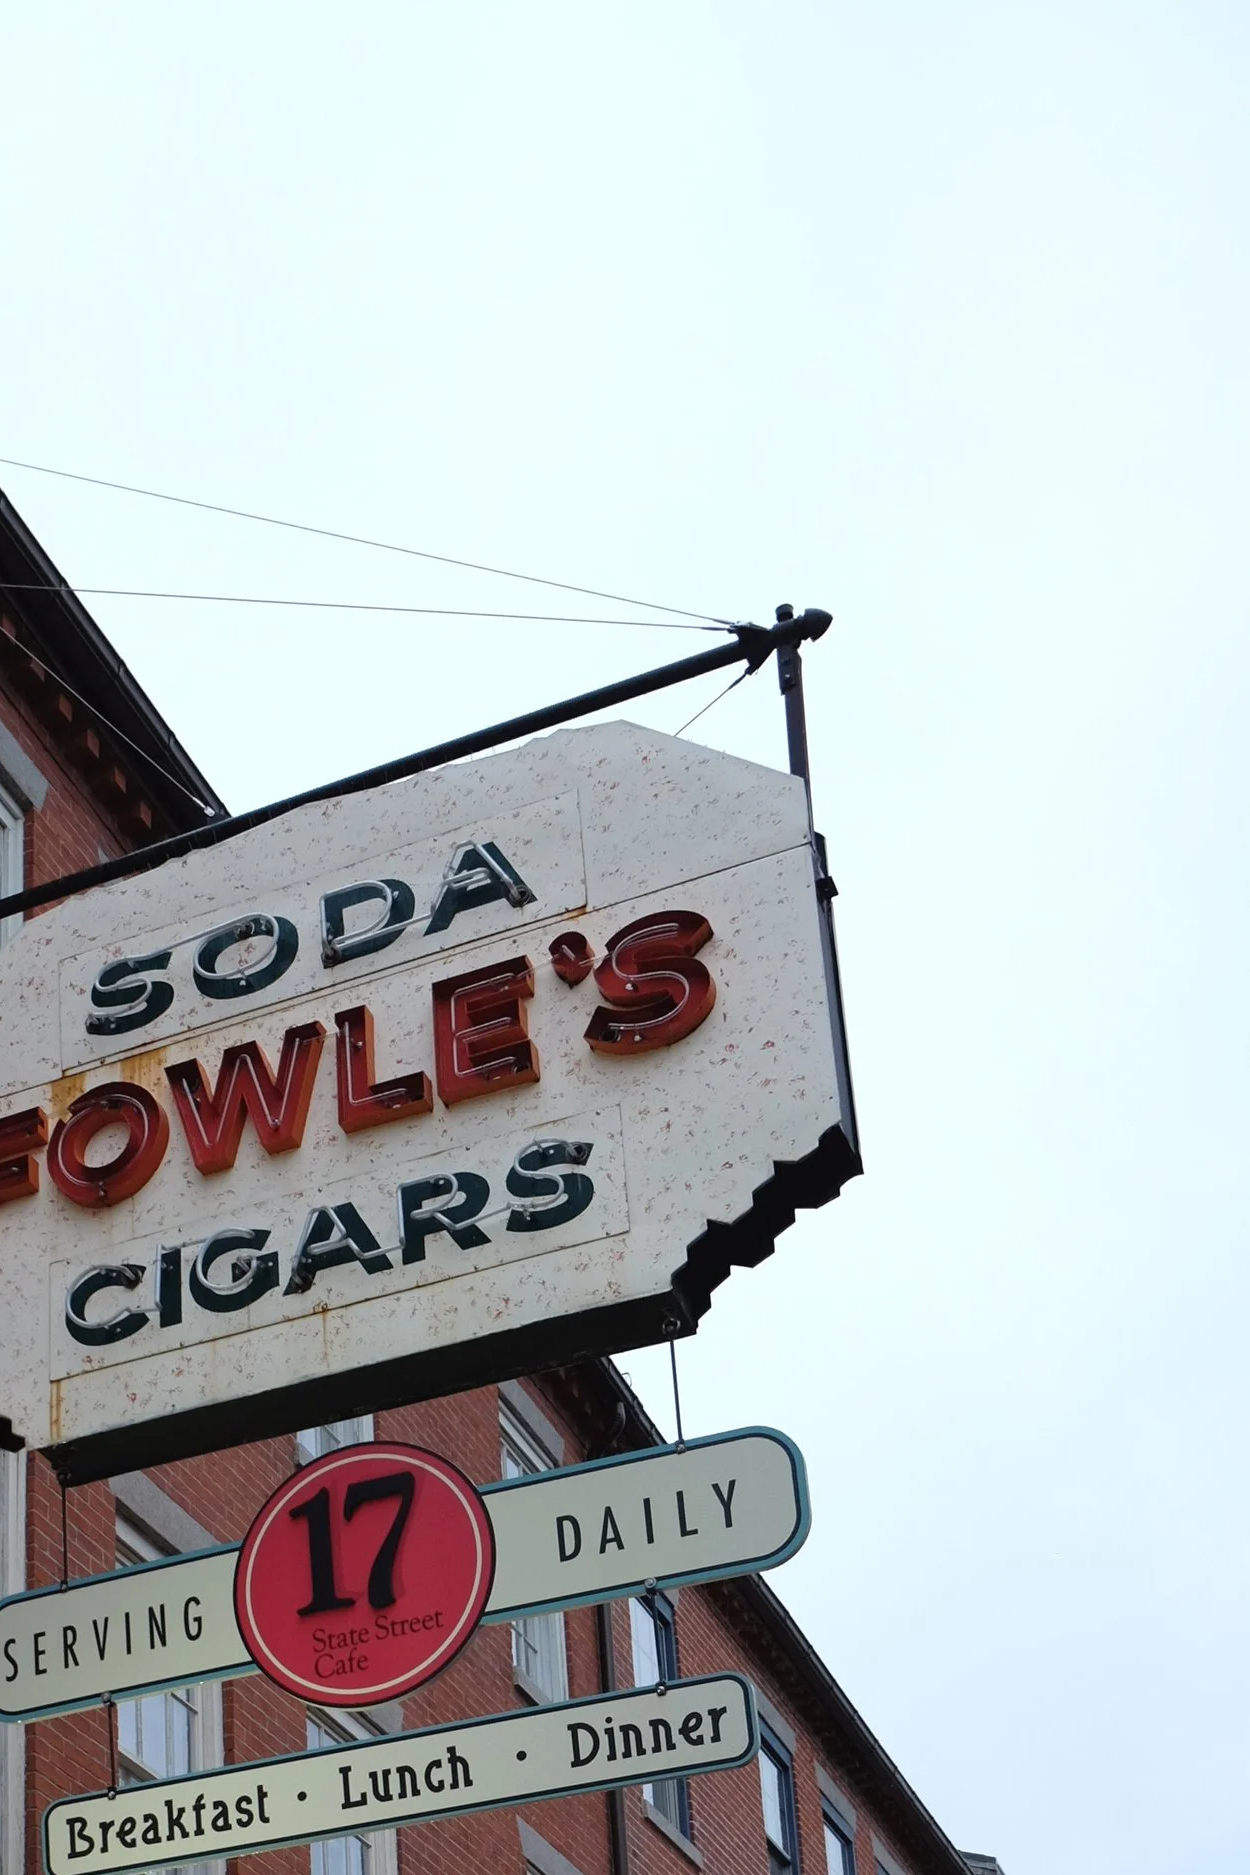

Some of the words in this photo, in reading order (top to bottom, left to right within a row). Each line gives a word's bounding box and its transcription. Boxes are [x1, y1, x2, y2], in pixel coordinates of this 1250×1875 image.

[85, 839, 537, 1037] SODA
[63, 1137, 596, 1346] CIGARS
[289, 1471, 416, 1617] 17
[556, 1477, 739, 1563] DAILY
[3, 1595, 204, 1683] SERVING
[312, 1627, 370, 1654] State
[374, 1609, 444, 1641] Street
[314, 1648, 369, 1679] Cafe
[65, 1782, 271, 1861] Breakfast
[338, 1745, 475, 1811] Lunch
[568, 1703, 729, 1770] Dinner
